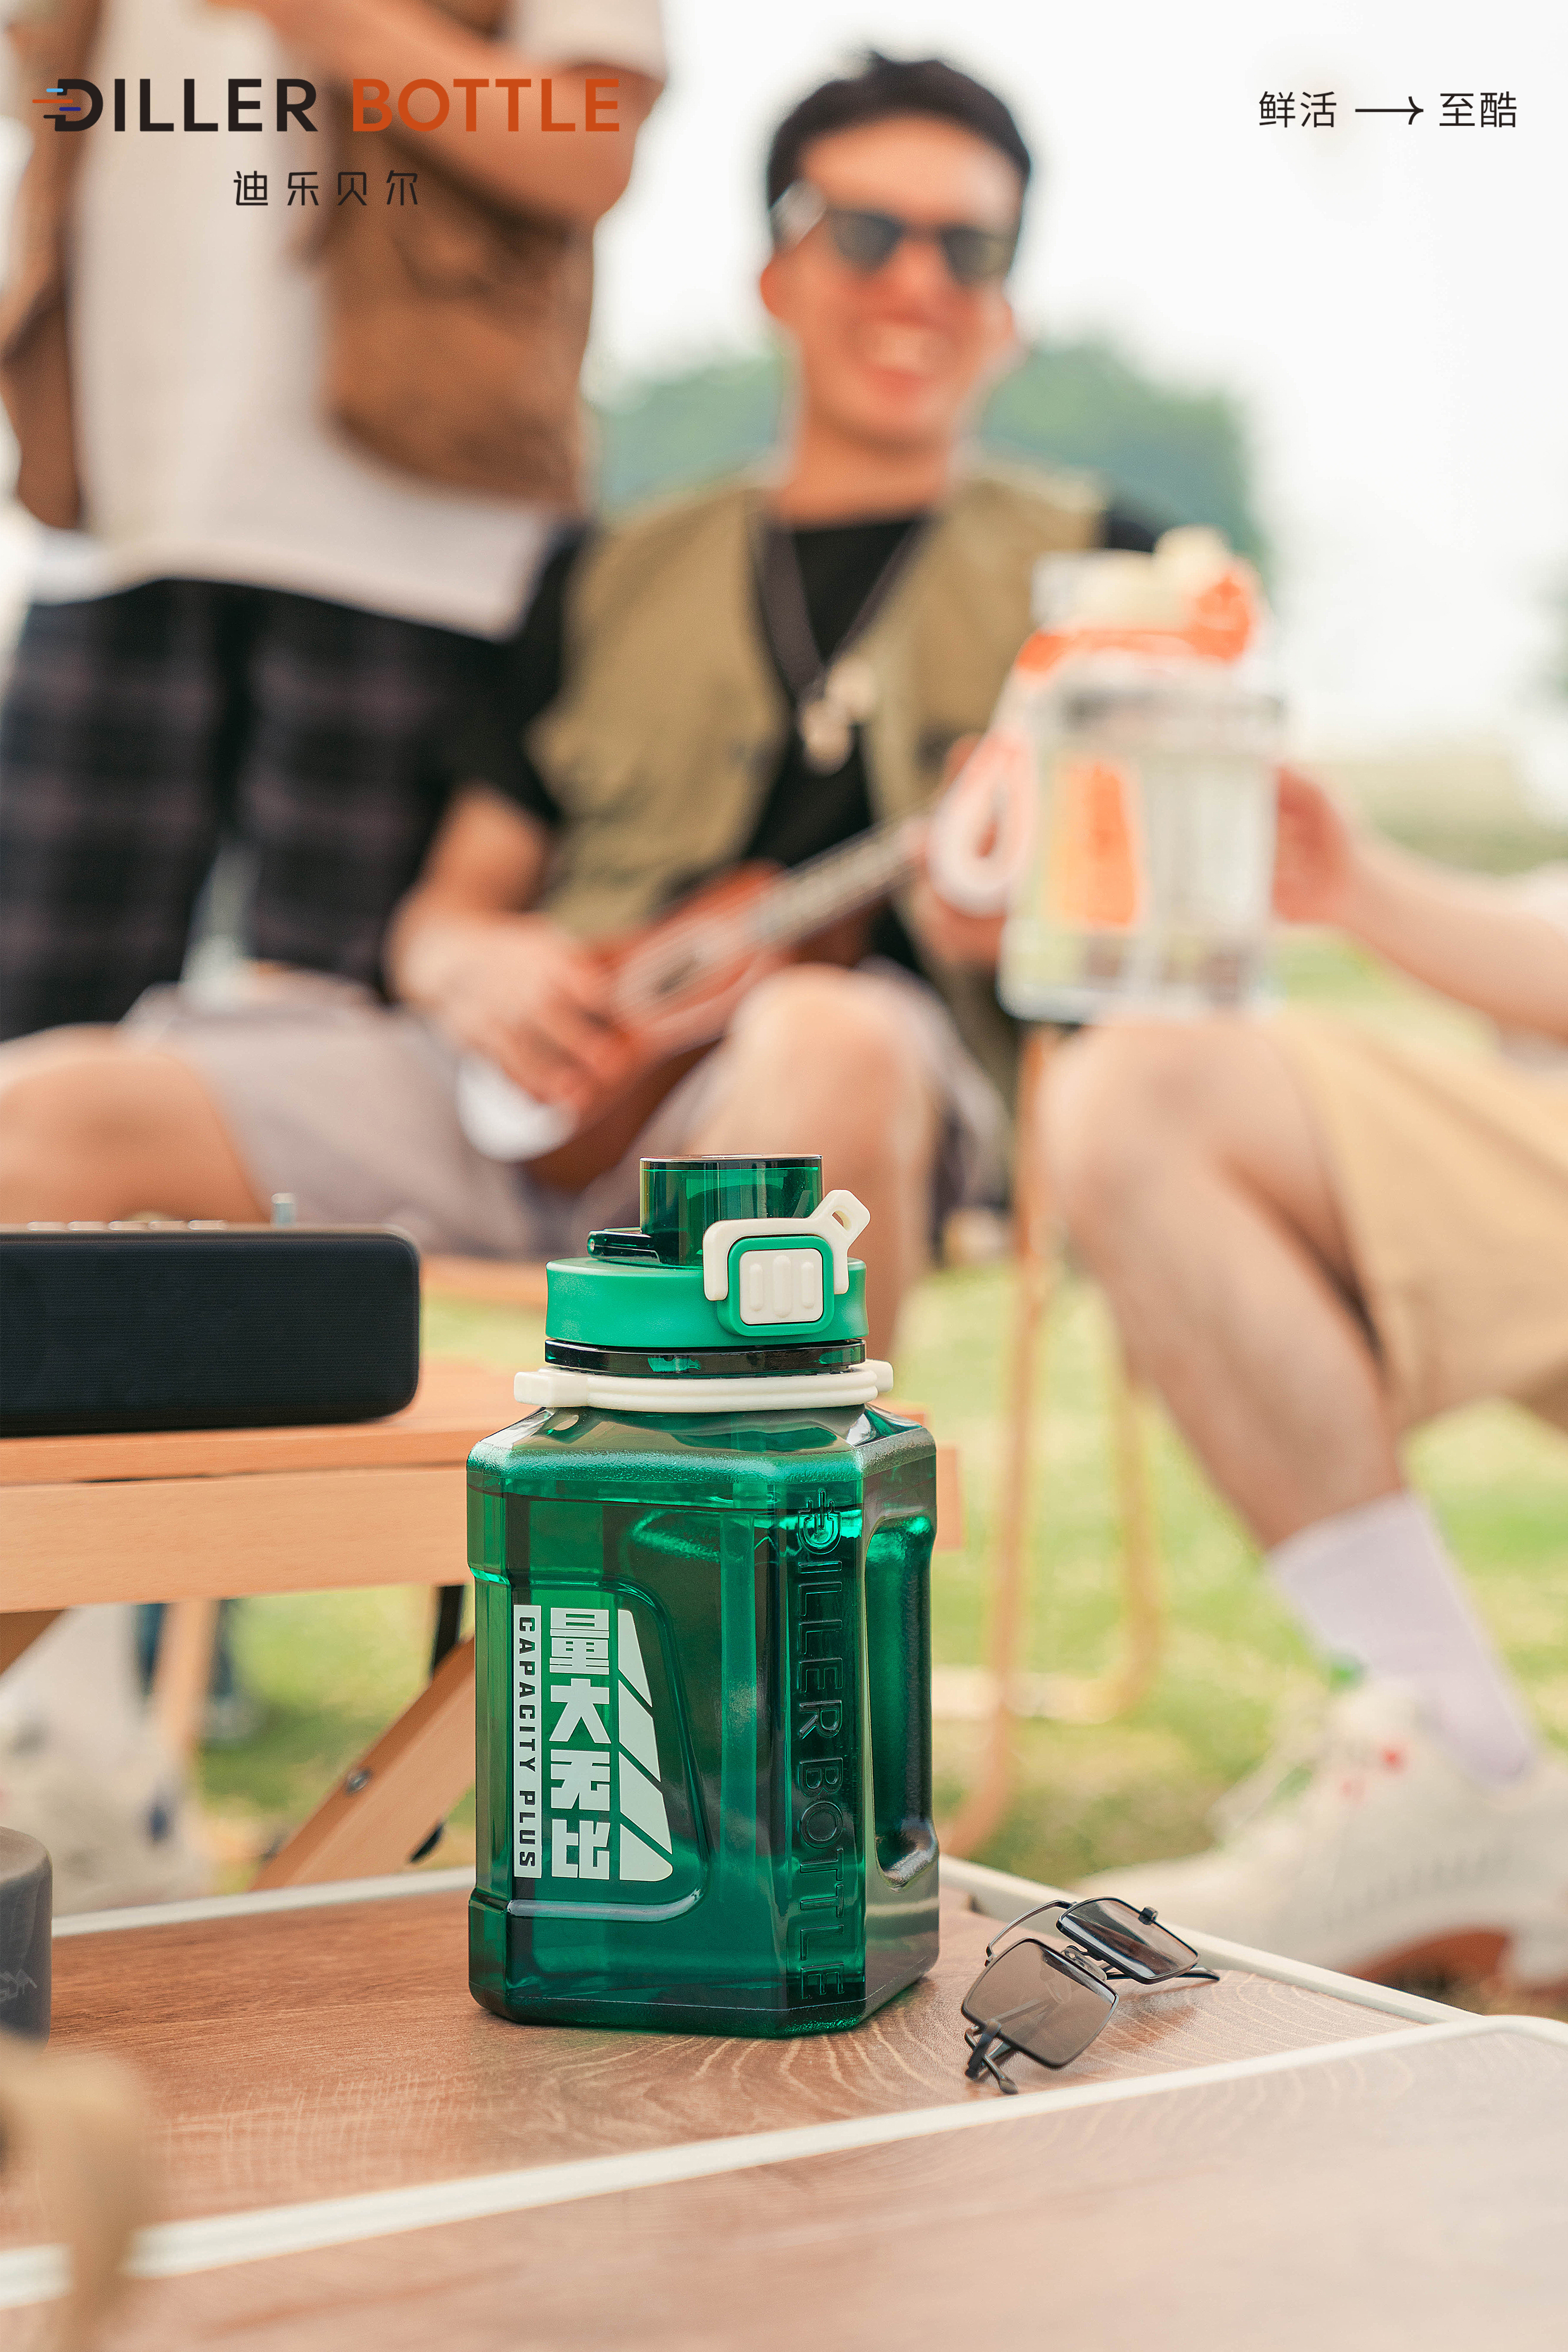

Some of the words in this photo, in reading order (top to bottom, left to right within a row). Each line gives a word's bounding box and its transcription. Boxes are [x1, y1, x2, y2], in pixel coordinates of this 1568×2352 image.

[518, 1616, 536, 1773] CAPACITY
[797, 1489, 843, 1740] DILLER
[518, 1790, 536, 1868] PLUS
[549, 1607, 612, 1880] 量大无比
[799, 1758, 845, 2000] BOTTLE
